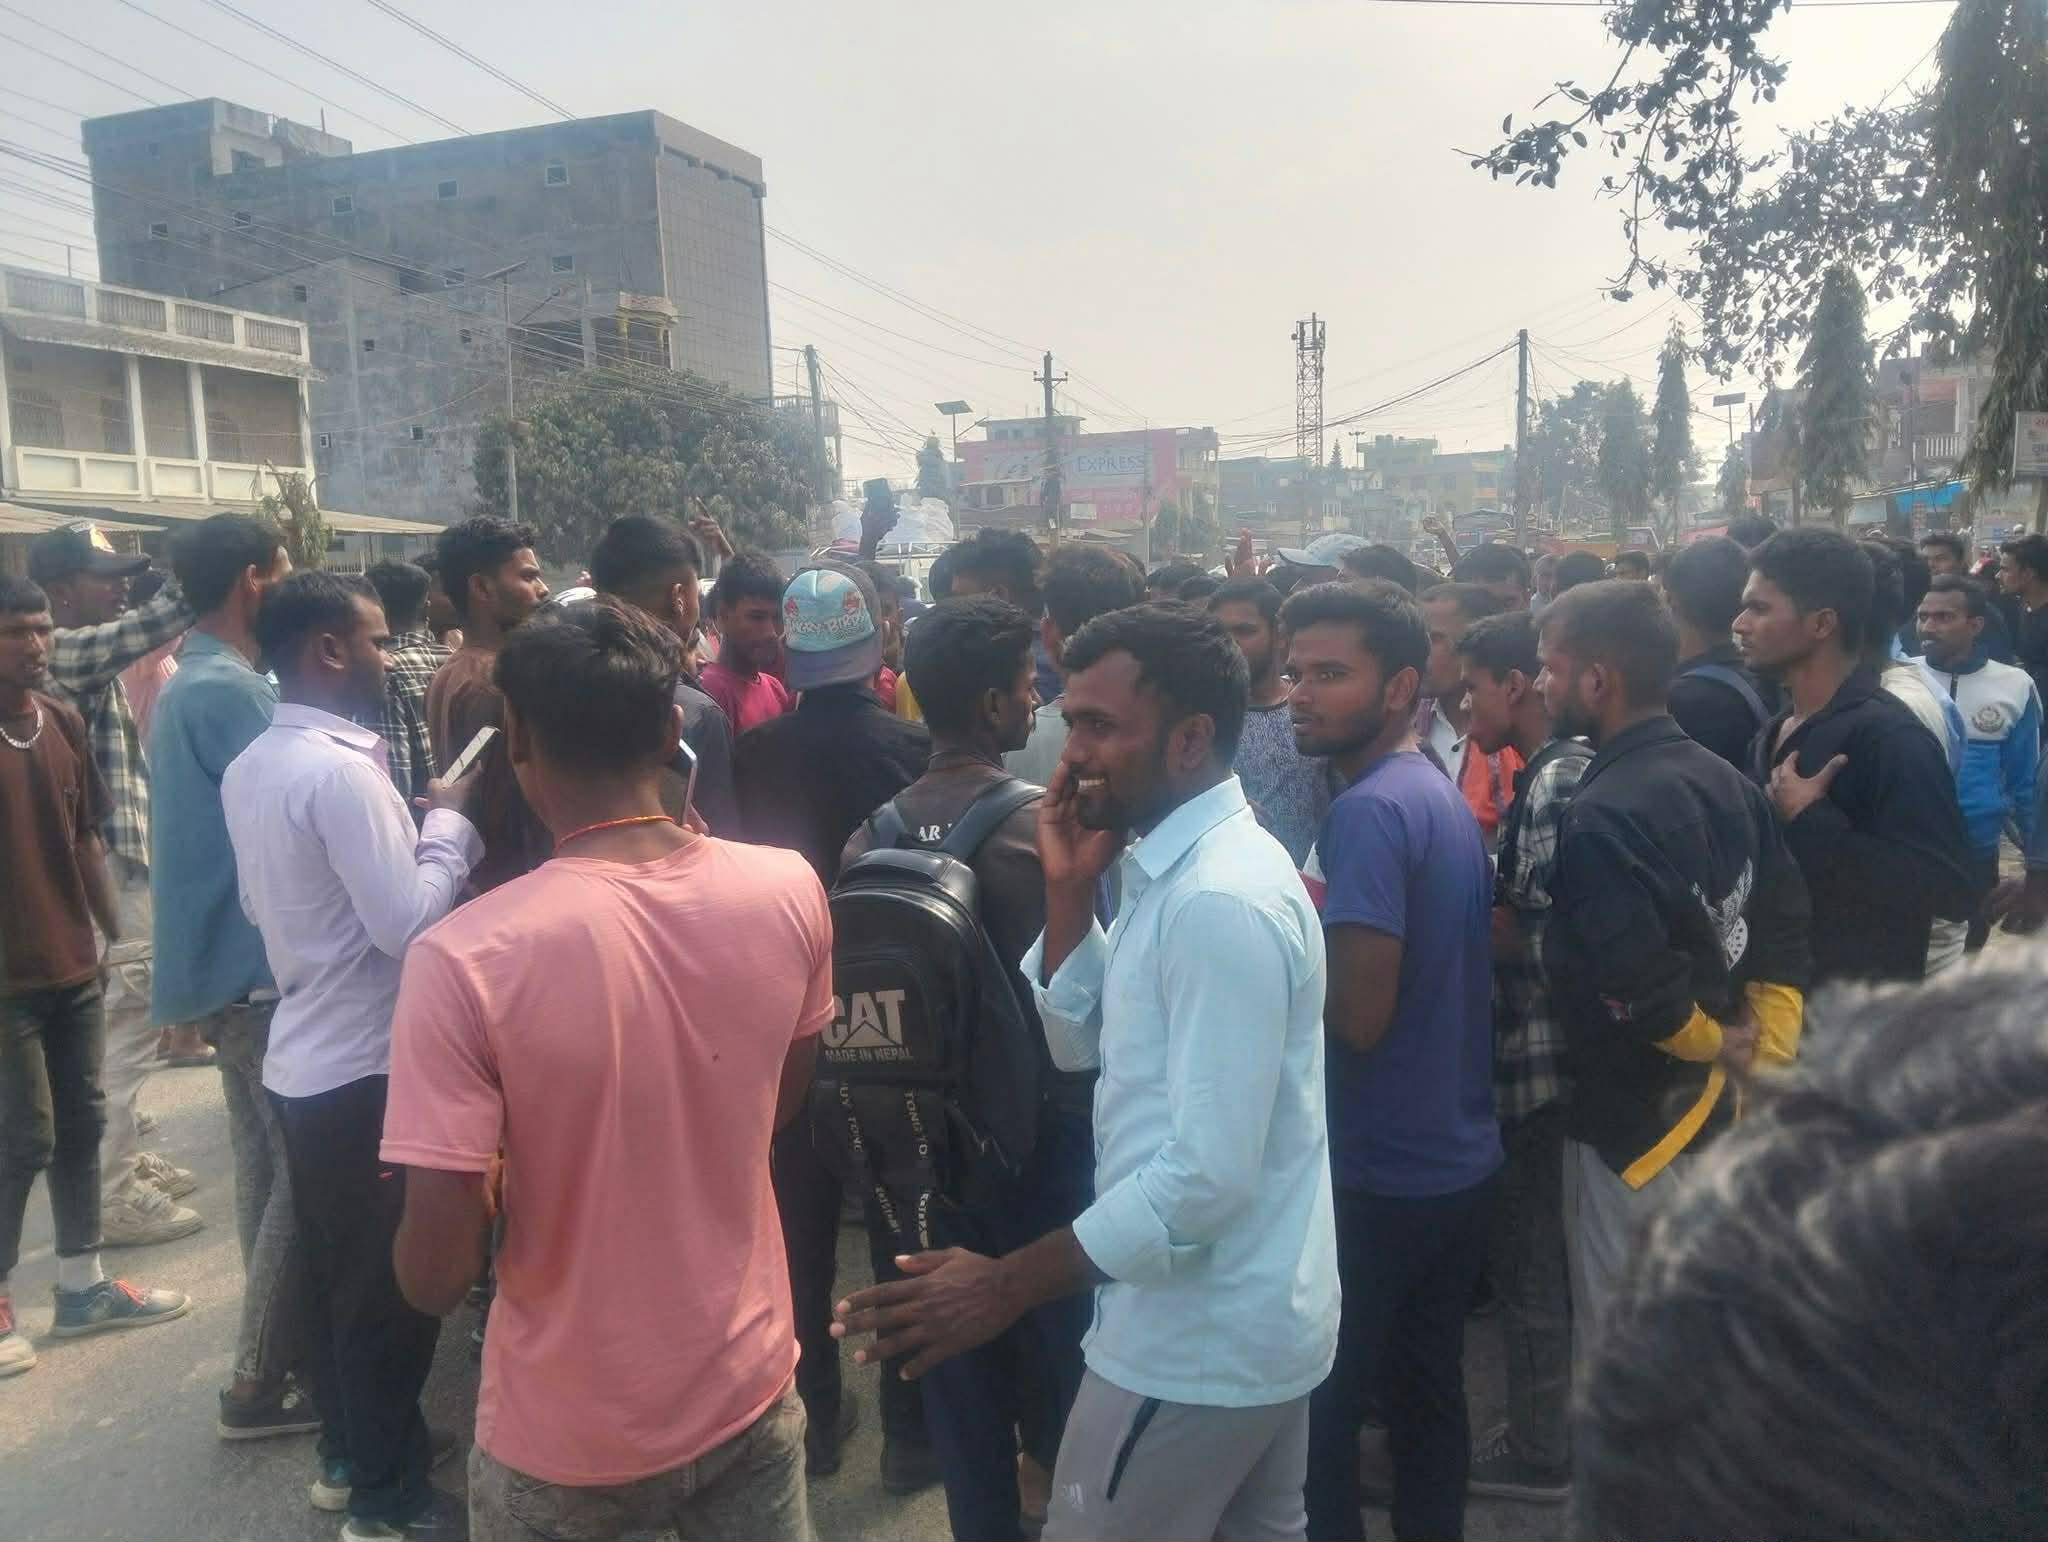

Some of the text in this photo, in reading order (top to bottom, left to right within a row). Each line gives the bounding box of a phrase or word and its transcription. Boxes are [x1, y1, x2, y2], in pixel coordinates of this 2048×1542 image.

[821, 989, 905, 1048] CAT
[824, 1046, 913, 1063] MADE IN NEPAL
